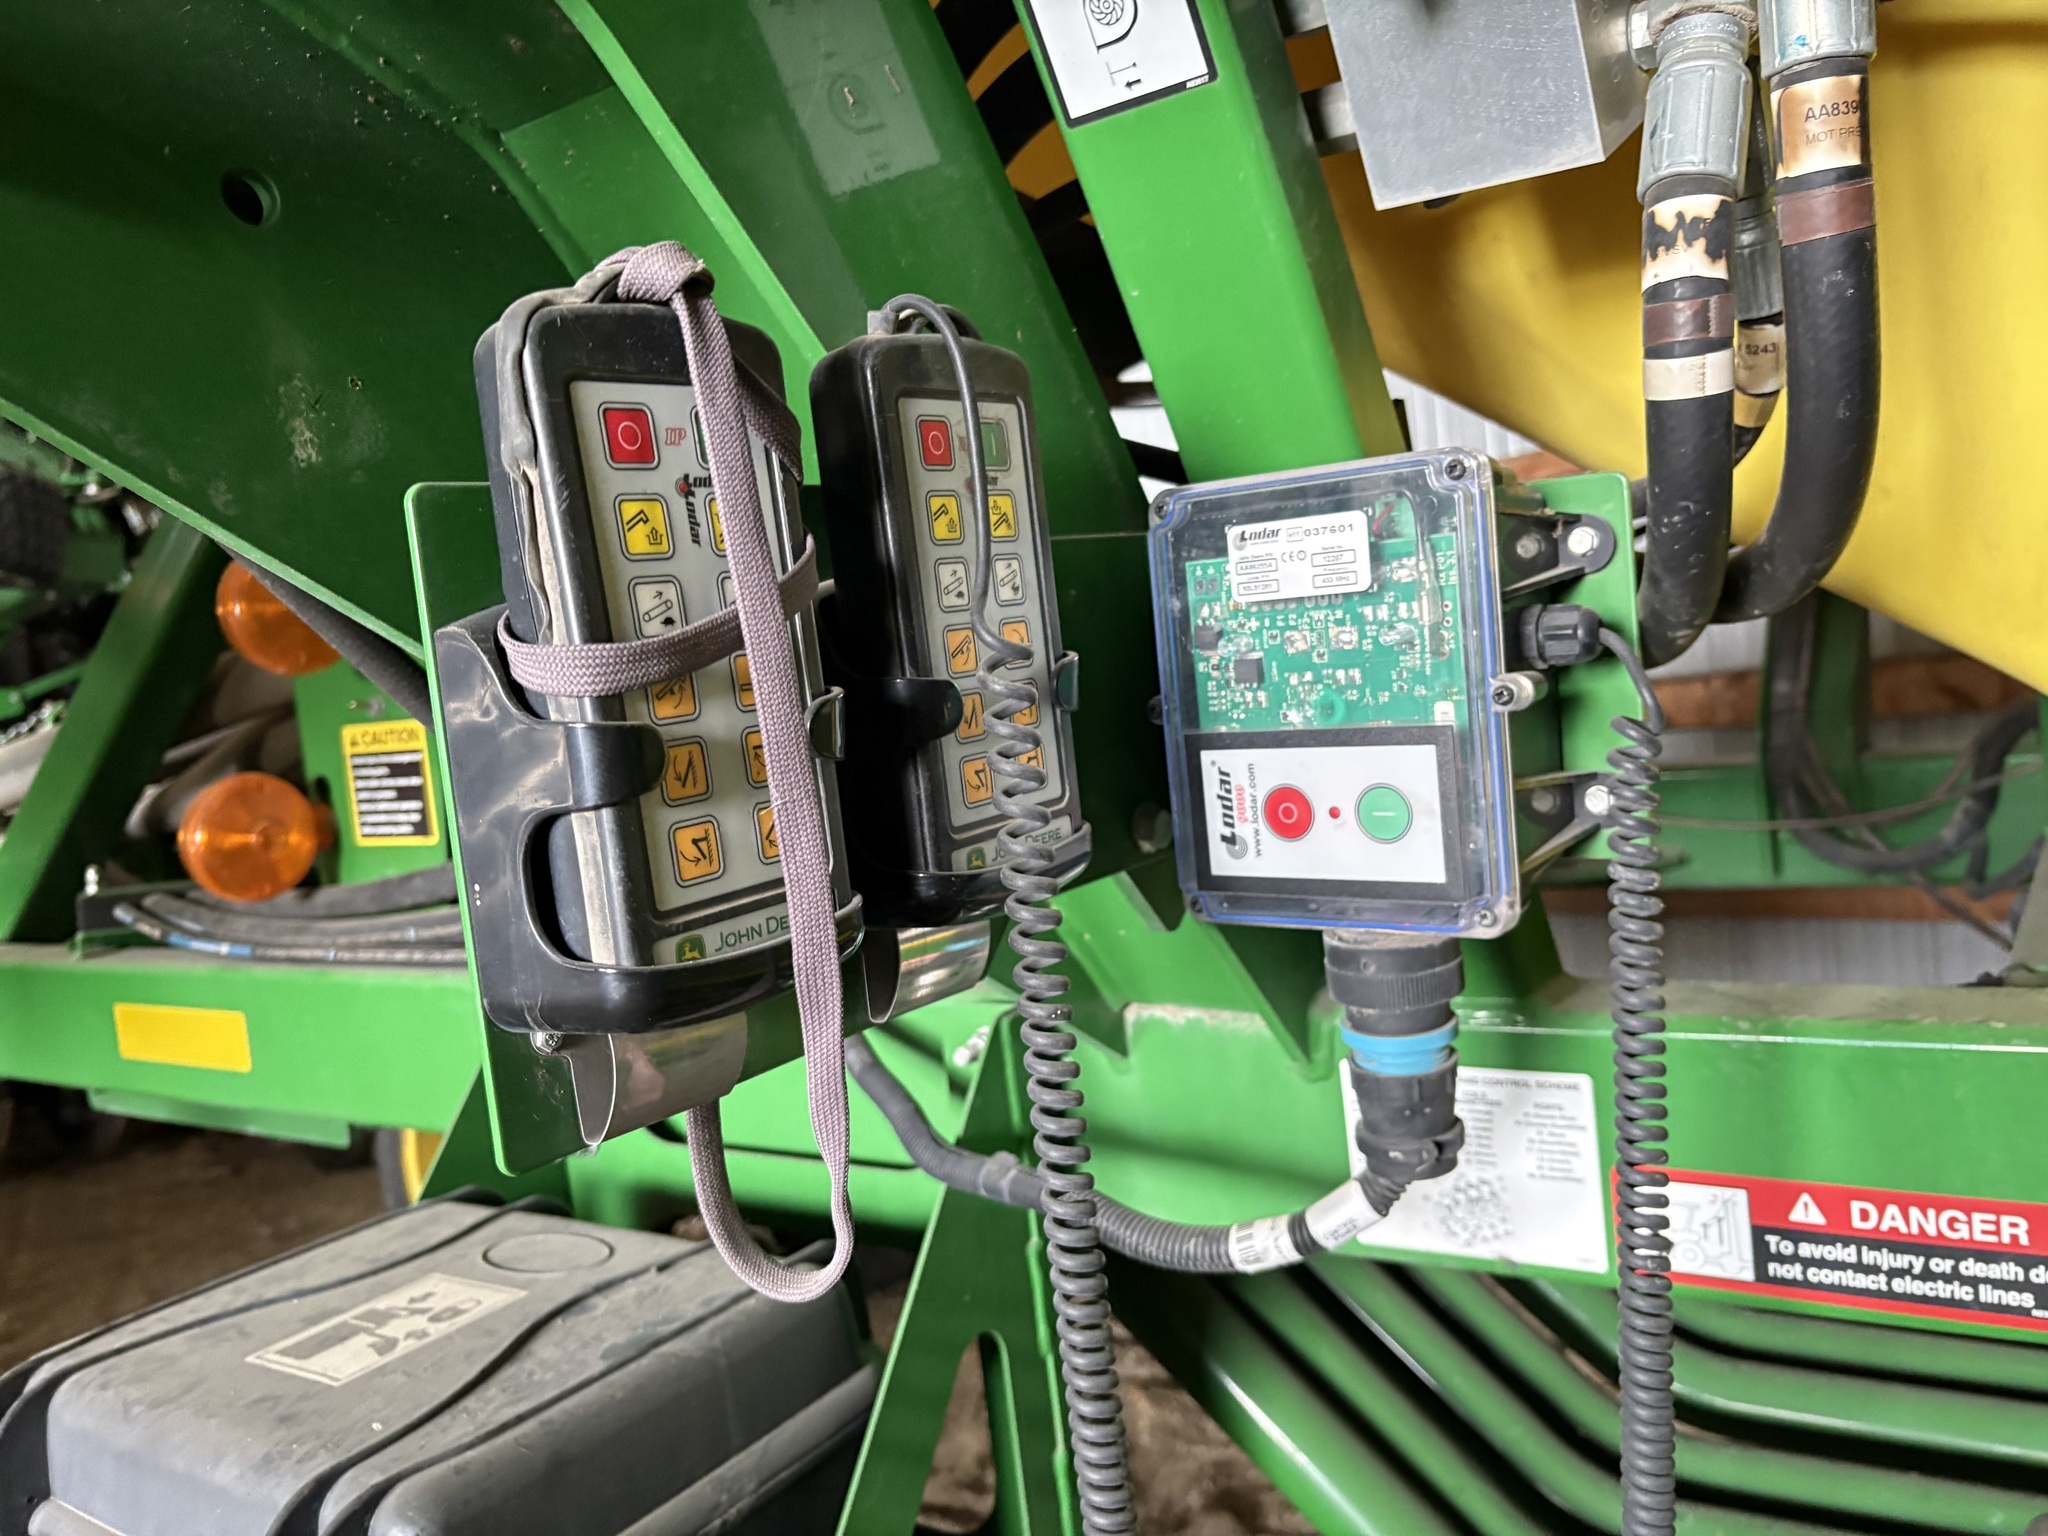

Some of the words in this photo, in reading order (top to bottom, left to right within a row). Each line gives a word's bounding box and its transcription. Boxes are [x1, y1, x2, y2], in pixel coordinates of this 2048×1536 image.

[1805, 129, 1834, 145] MOT
[1240, 527, 1281, 542] Lodar
[1303, 523, 1354, 537] 037601
[1217, 766, 1238, 846] Lodar
[1248, 763, 1262, 858] www.lodar.com
[715, 922, 763, 953] JOHN
[1850, 1200, 2030, 1246] DANGER
[1764, 1234, 1794, 1255] To
[1798, 1242, 1857, 1263] avoid
[1861, 1246, 1925, 1275] injury
[1929, 1256, 1955, 1274] or
[1958, 1257, 2024, 1282] death
[2029, 1265, 2048, 1284] d
[1767, 1261, 1804, 1281] not
[1806, 1266, 1888, 1291] contact
[1891, 1277, 1974, 1301] electric
[1978, 1284, 2036, 1308] lines
